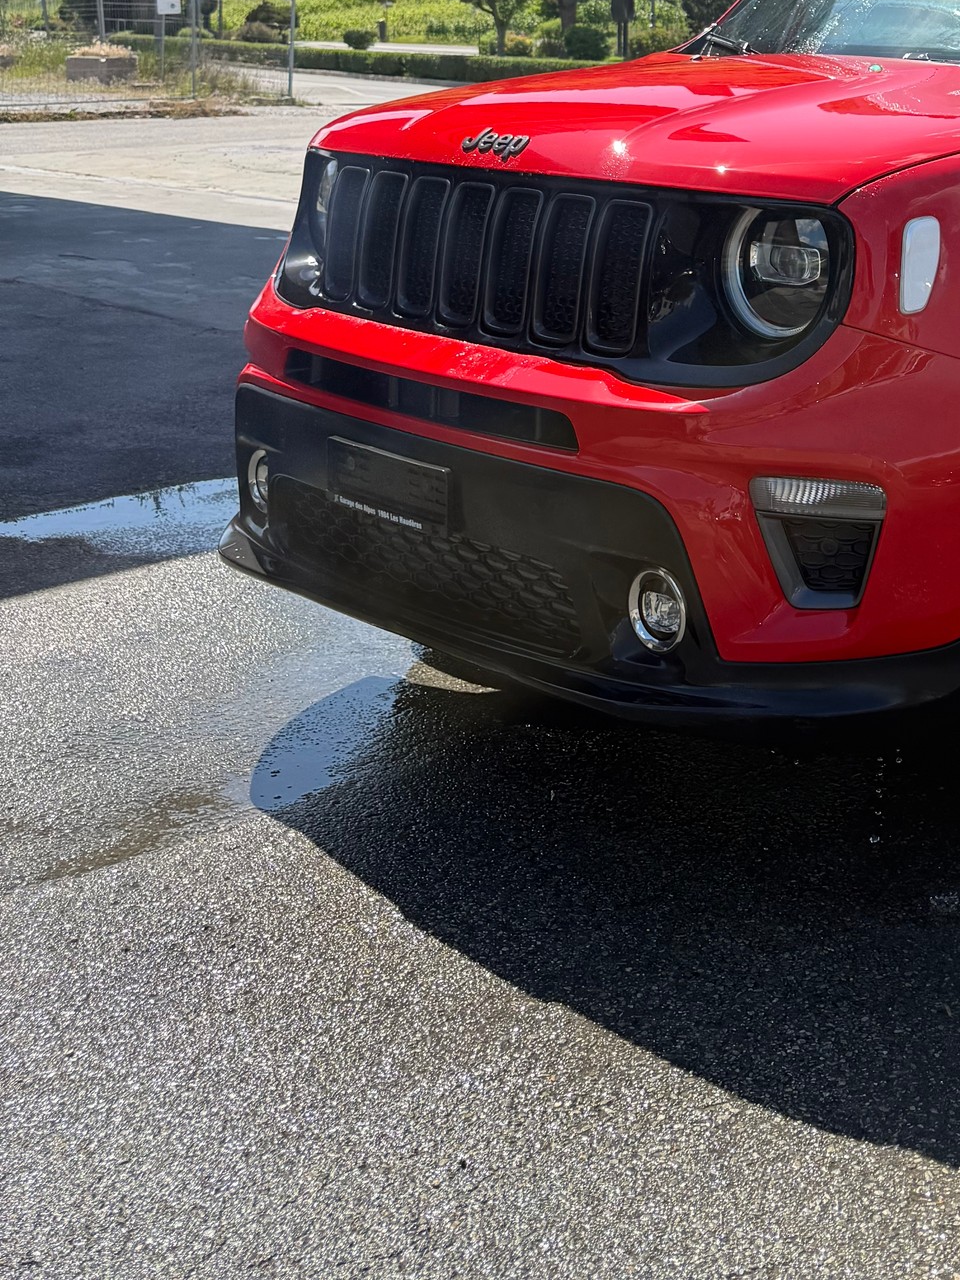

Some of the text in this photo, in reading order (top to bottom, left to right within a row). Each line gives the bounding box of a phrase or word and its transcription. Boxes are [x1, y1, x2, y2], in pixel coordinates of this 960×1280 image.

[462, 127, 530, 163] Jeep
[339, 495, 355, 508] Garage
[355, 501, 363, 511] des
[390, 512, 399, 523] Les
